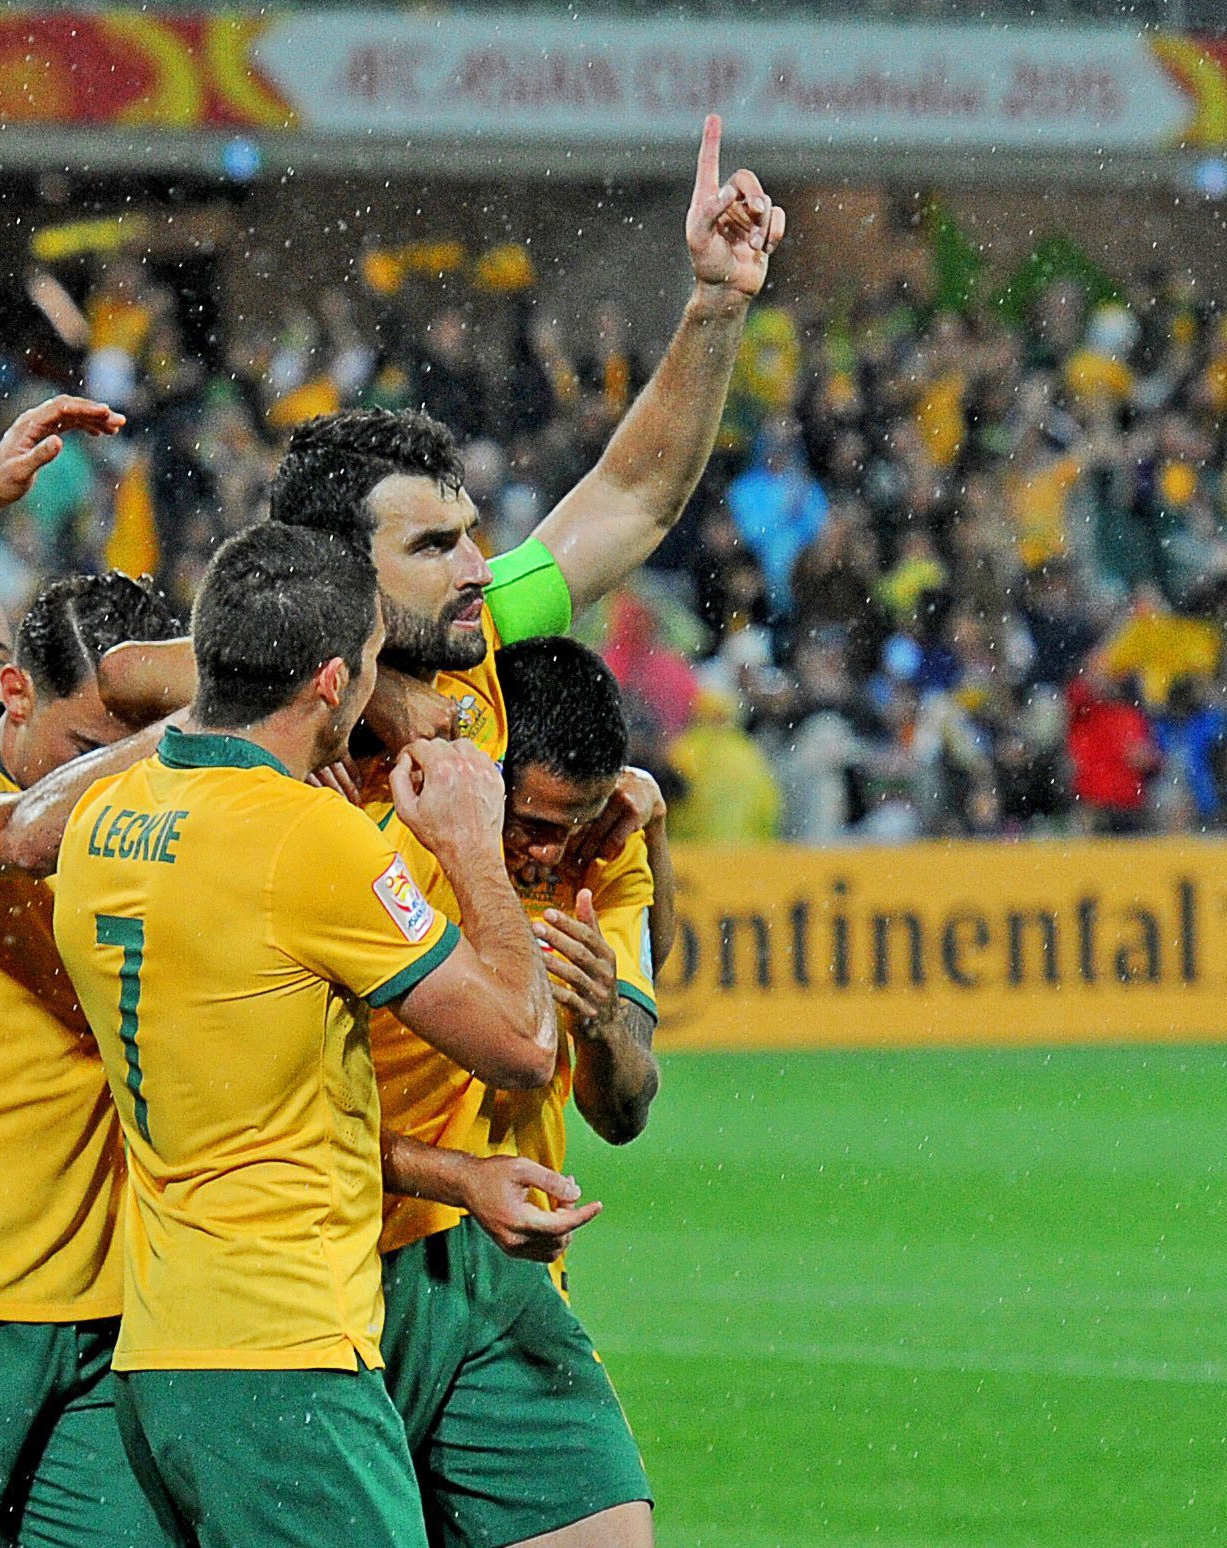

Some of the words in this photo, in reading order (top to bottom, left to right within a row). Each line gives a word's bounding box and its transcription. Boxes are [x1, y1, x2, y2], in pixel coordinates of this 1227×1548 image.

[88, 805, 190, 863] LECKIE
[658, 870, 1200, 1026] ontinental
[94, 913, 154, 1147] 7
